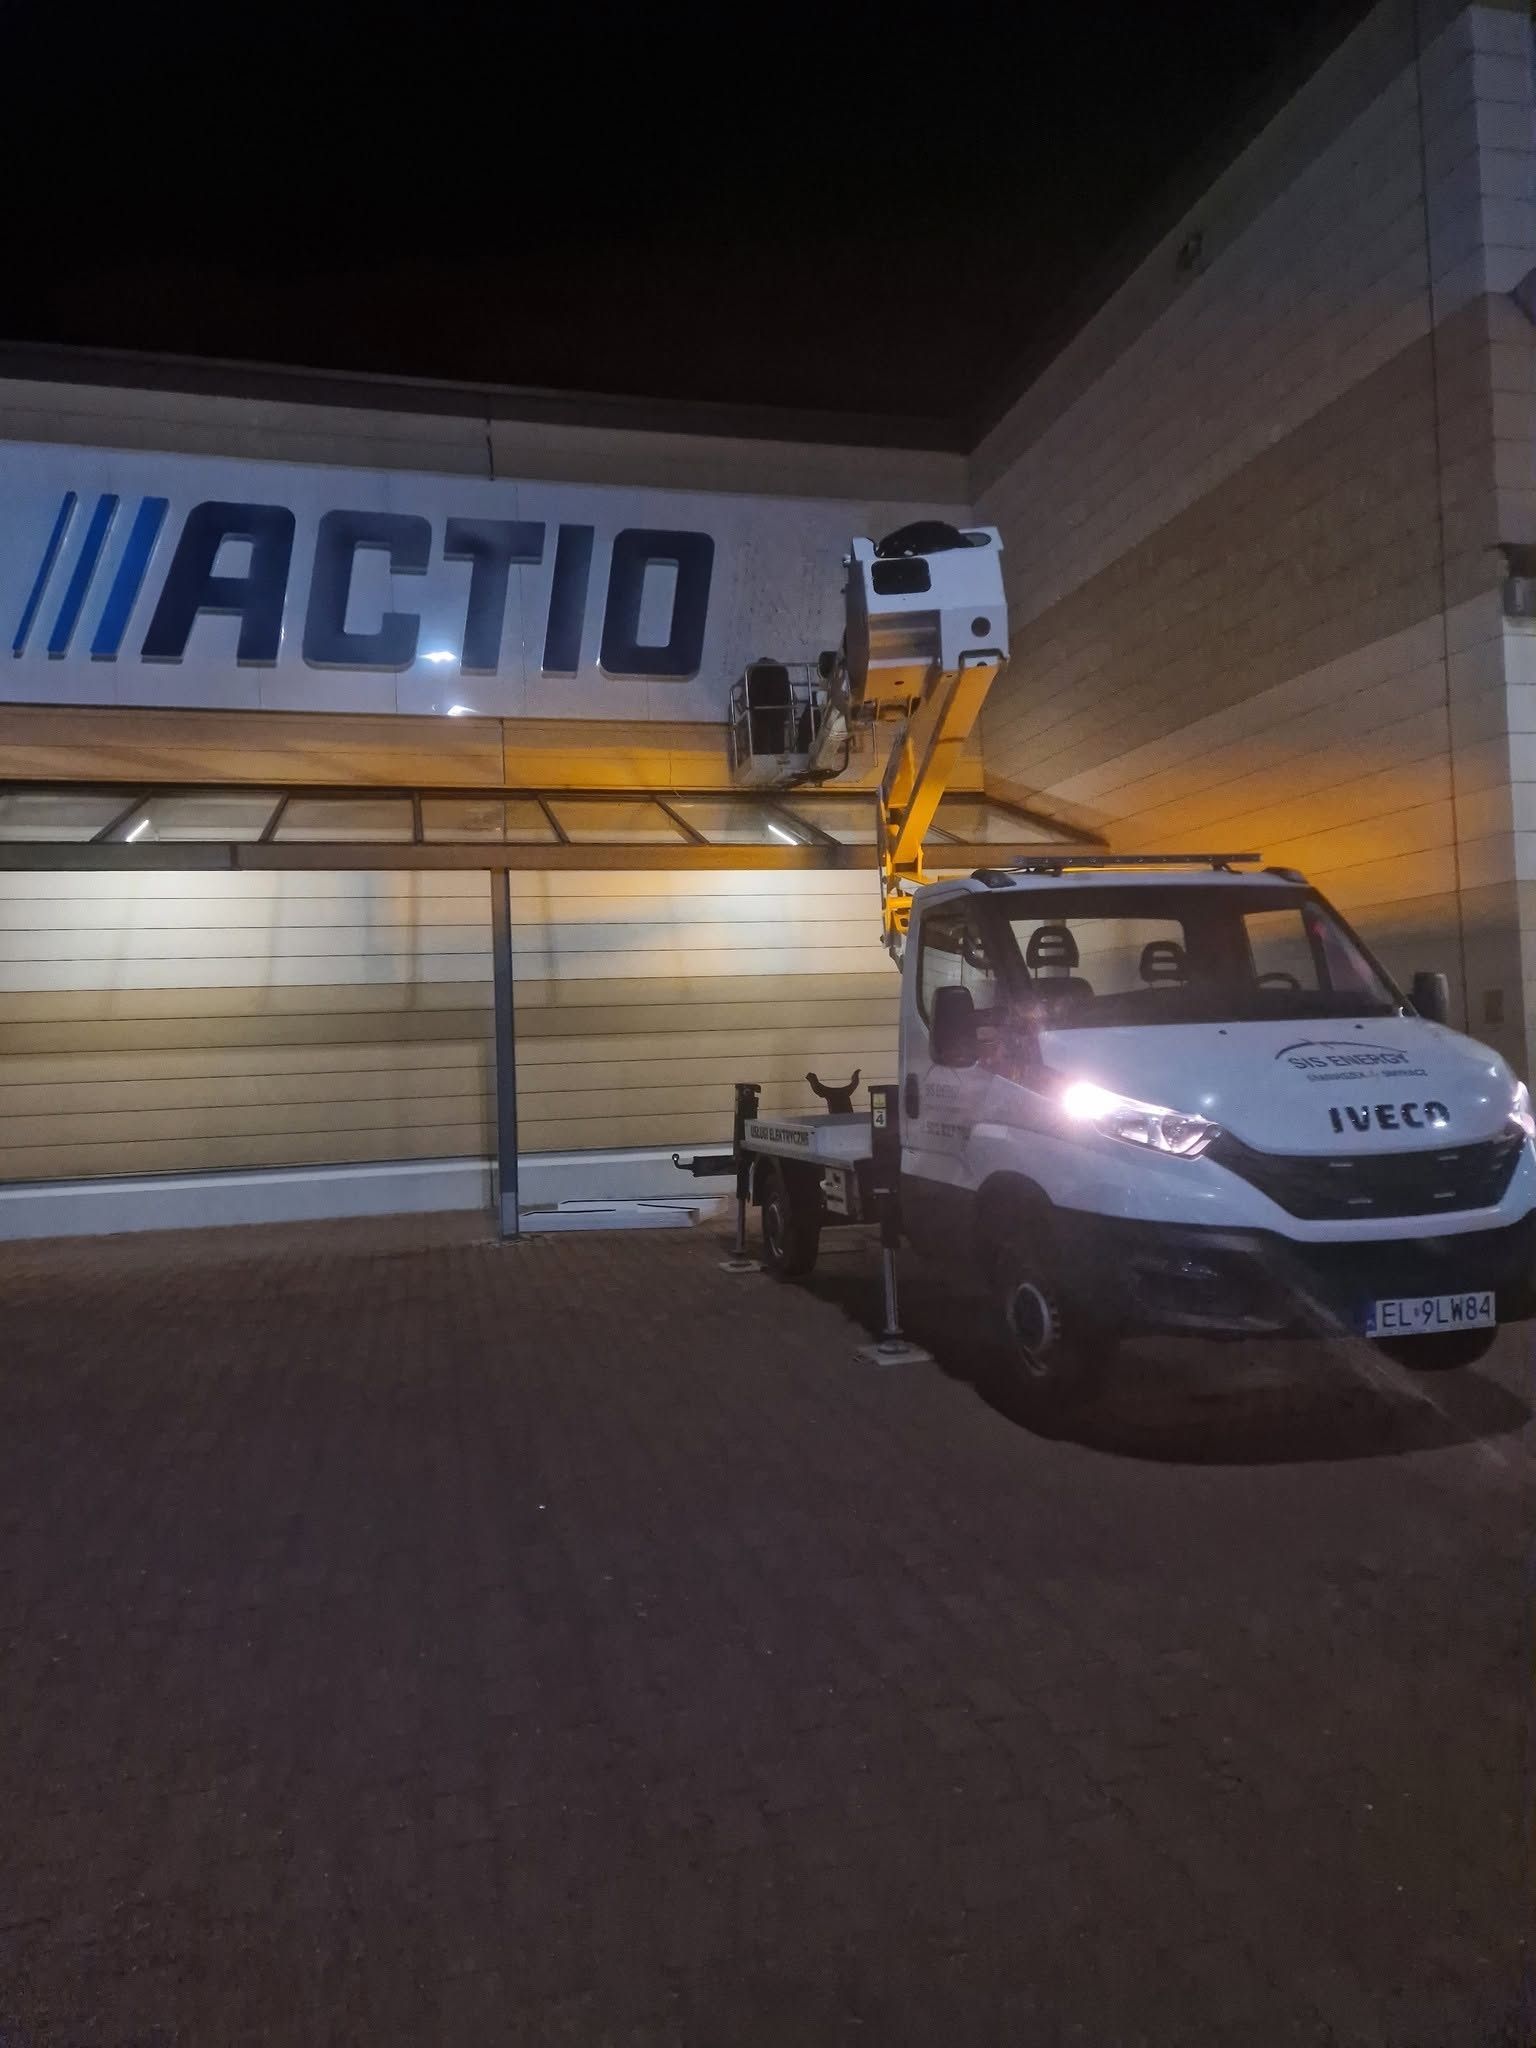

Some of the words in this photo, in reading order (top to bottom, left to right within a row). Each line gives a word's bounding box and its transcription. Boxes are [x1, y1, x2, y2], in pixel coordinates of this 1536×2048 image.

[140, 500, 716, 678] ACTIO
[1288, 1055, 1327, 1070] SIS
[1328, 1052, 1409, 1068] ENERGY
[875, 1113, 884, 1125] 4
[1328, 1101, 1450, 1134] IVECO
